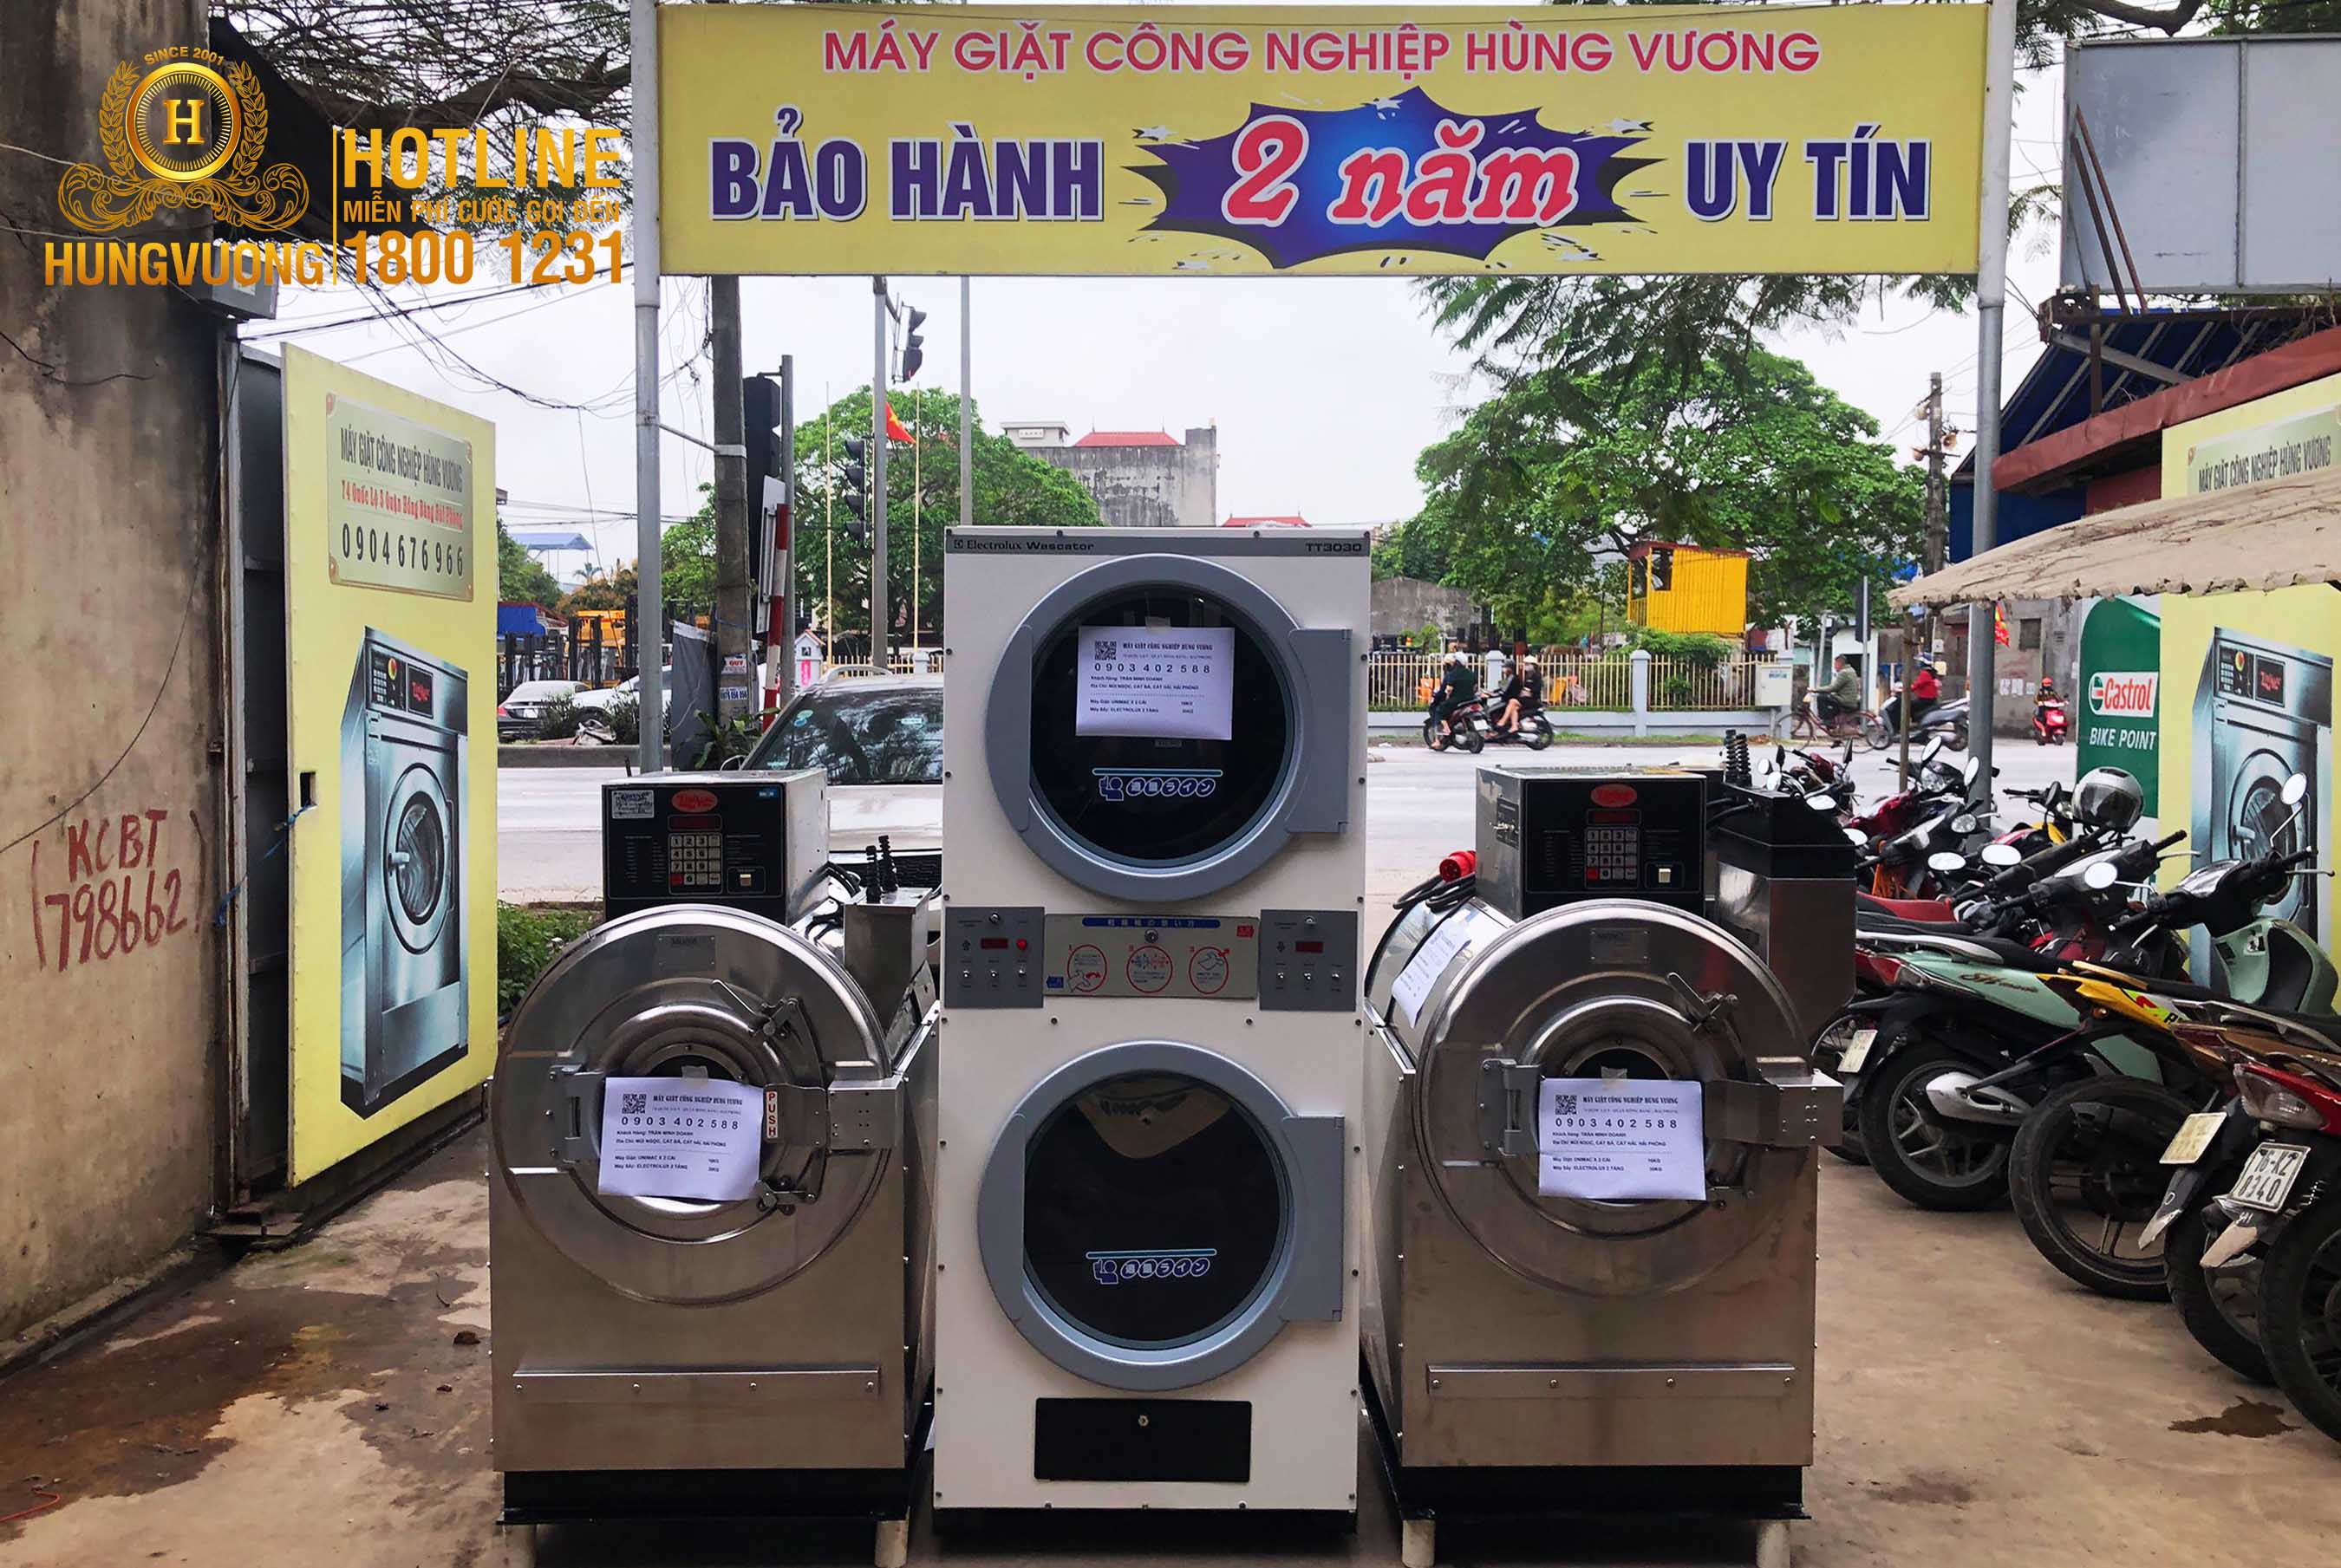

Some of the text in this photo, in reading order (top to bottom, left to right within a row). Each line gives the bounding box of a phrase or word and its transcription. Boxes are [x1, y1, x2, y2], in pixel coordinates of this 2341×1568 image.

[825, 21, 1820, 80] MÁY GIẶT CÔNG NGHIỆP HÙNG VƯƠNG
[709, 106, 1931, 225] BẢO HÀNH 2 năm UY TÍN
[341, 423, 357, 464] MÁY
[359, 430, 375, 474] GIẶT
[376, 434, 395, 477] CÔNG
[398, 446, 422, 486] NGHIỆP
[423, 449, 440, 487] HÙNG
[2199, 462, 2214, 492] MÁY
[2230, 454, 2249, 487] CÔNG
[2279, 440, 2301, 477] HÙNG
[967, 539, 1095, 551] Electrolux Wascator
[1305, 543, 1362, 552] TT3030
[2104, 678, 2152, 711] Castrol
[2089, 727, 2157, 750] BIKE POINT
[1128, 779, 1214, 795] ライン
[68, 810, 167, 882] KCBT
[45, 869, 187, 973] 798662
[1124, 1260, 1210, 1276] ライン
